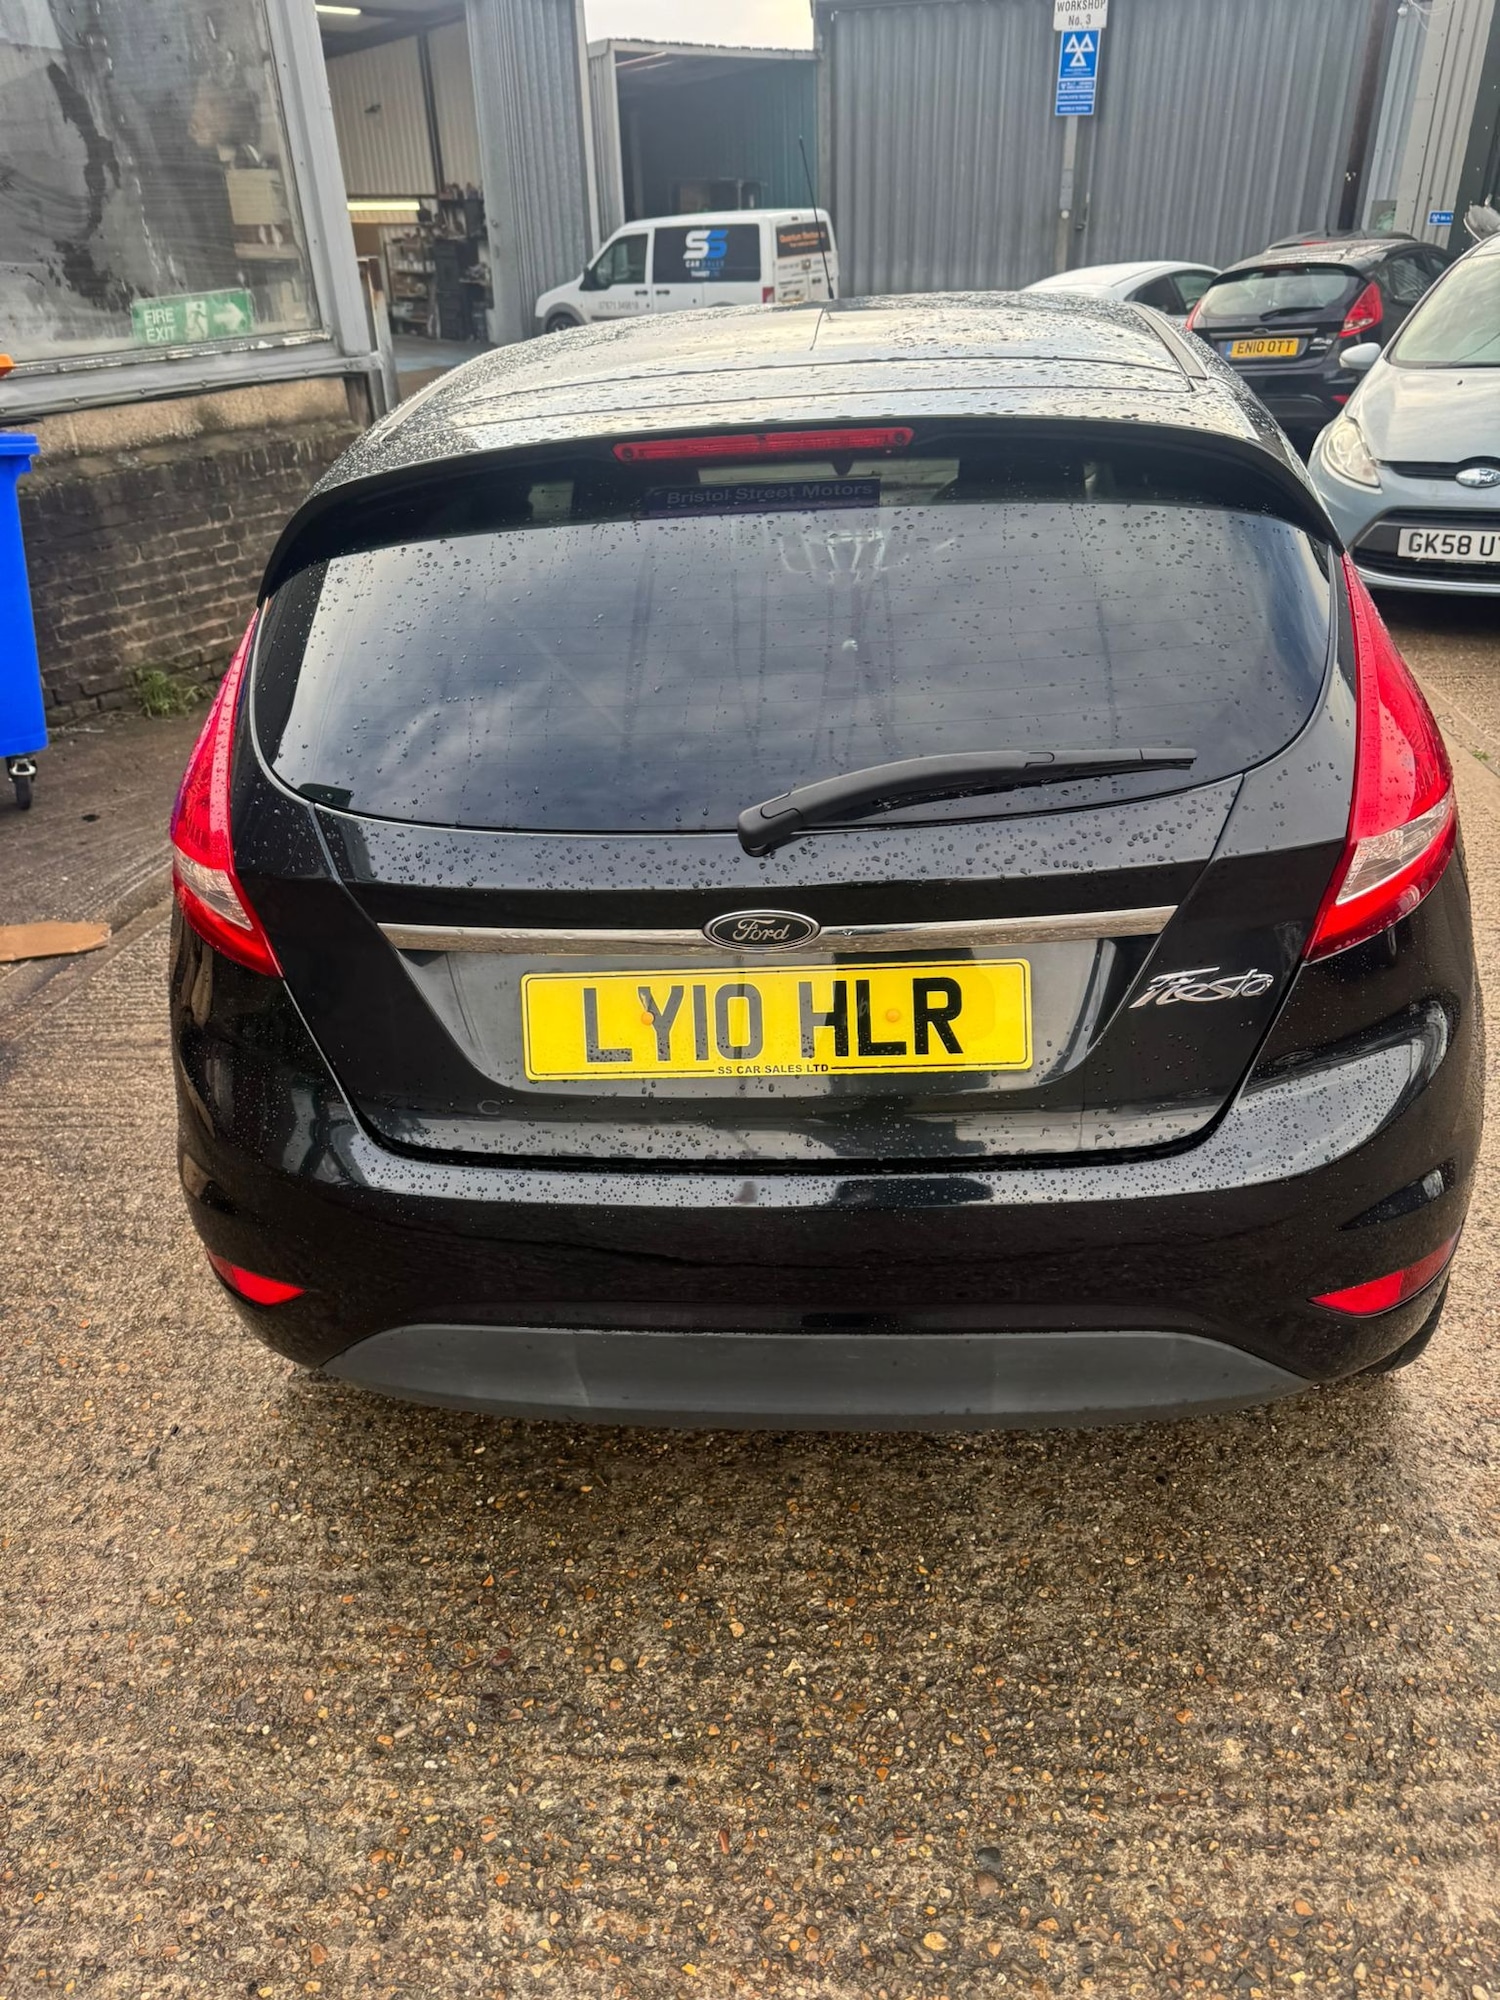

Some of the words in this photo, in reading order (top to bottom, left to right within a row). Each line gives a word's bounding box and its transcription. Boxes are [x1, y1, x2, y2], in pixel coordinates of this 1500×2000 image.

[1057, 0, 1105, 11] WORKSHOP
[1069, 15, 1083, 26] No.
[1086, 13, 1092, 25] 3
[682, 229, 729, 259] SS
[144, 307, 175, 325] FIRE
[146, 326, 176, 343] EXIT
[1237, 341, 1265, 354] EN10
[1267, 340, 1294, 353] OTT
[666, 488, 729, 505] Bristol
[735, 485, 796, 501] Street
[803, 482, 873, 498] Motors
[1408, 532, 1472, 555] GK58
[1479, 535, 1500, 556] U
[733, 918, 790, 941] Ford
[1128, 966, 1275, 1009] Fiesta
[583, 983, 763, 1063] LY10
[799, 976, 964, 1058] HLR
[718, 1065, 733, 1075] SS
[736, 1065, 761, 1075] CAR
[764, 1063, 803, 1074] SALES
[806, 1063, 829, 1073] LTD
